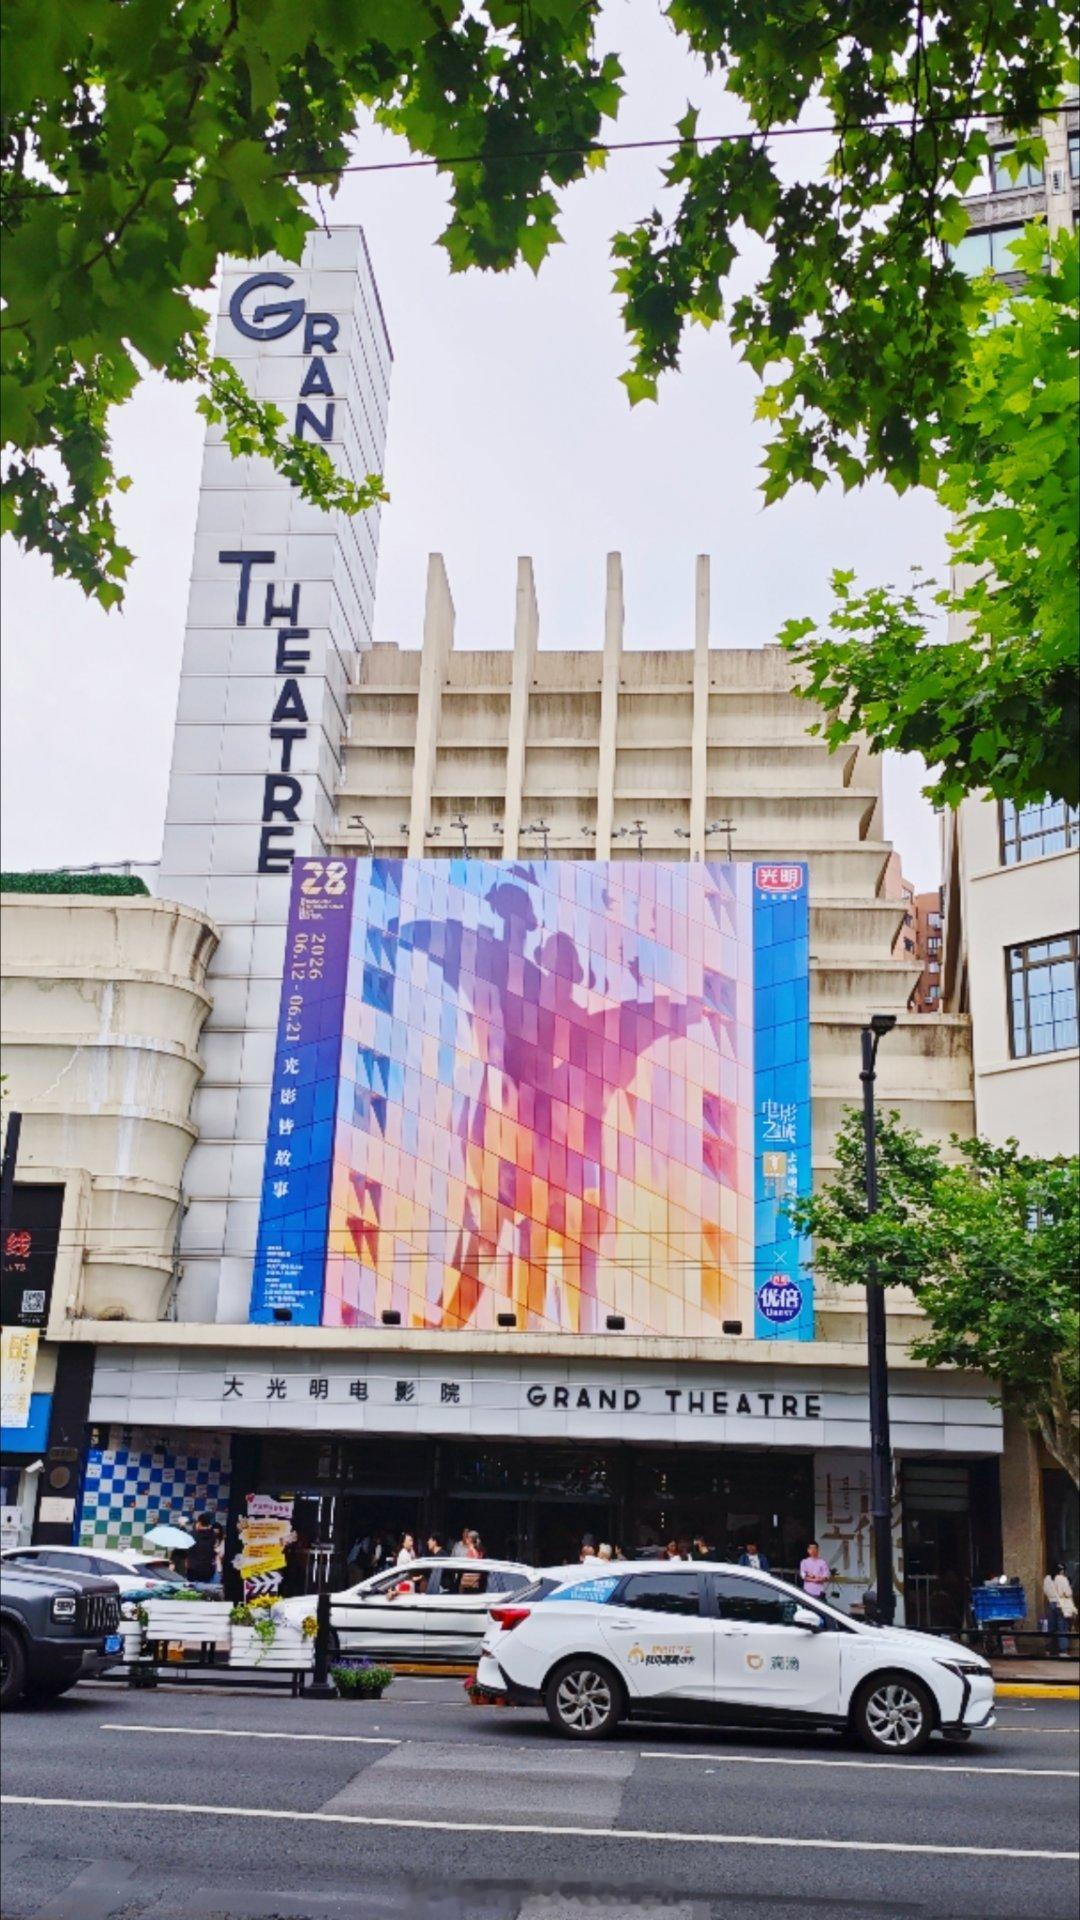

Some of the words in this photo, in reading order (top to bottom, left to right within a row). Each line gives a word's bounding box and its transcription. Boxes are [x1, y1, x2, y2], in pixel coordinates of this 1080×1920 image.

[229, 272, 340, 487] GRAN
[218, 550, 310, 874] THEATRE
[300, 861, 348, 895] 28
[760, 868, 798, 885] 光明
[291, 933, 308, 980] 06.12
[309, 933, 326, 980] 2026
[286, 995, 303, 1041] 06.21
[760, 1288, 799, 1308] 优倍
[223, 1376, 461, 1404] 大光明电影院
[526, 1385, 641, 1410] GRAND
[665, 1389, 821, 1418] THEATRE
